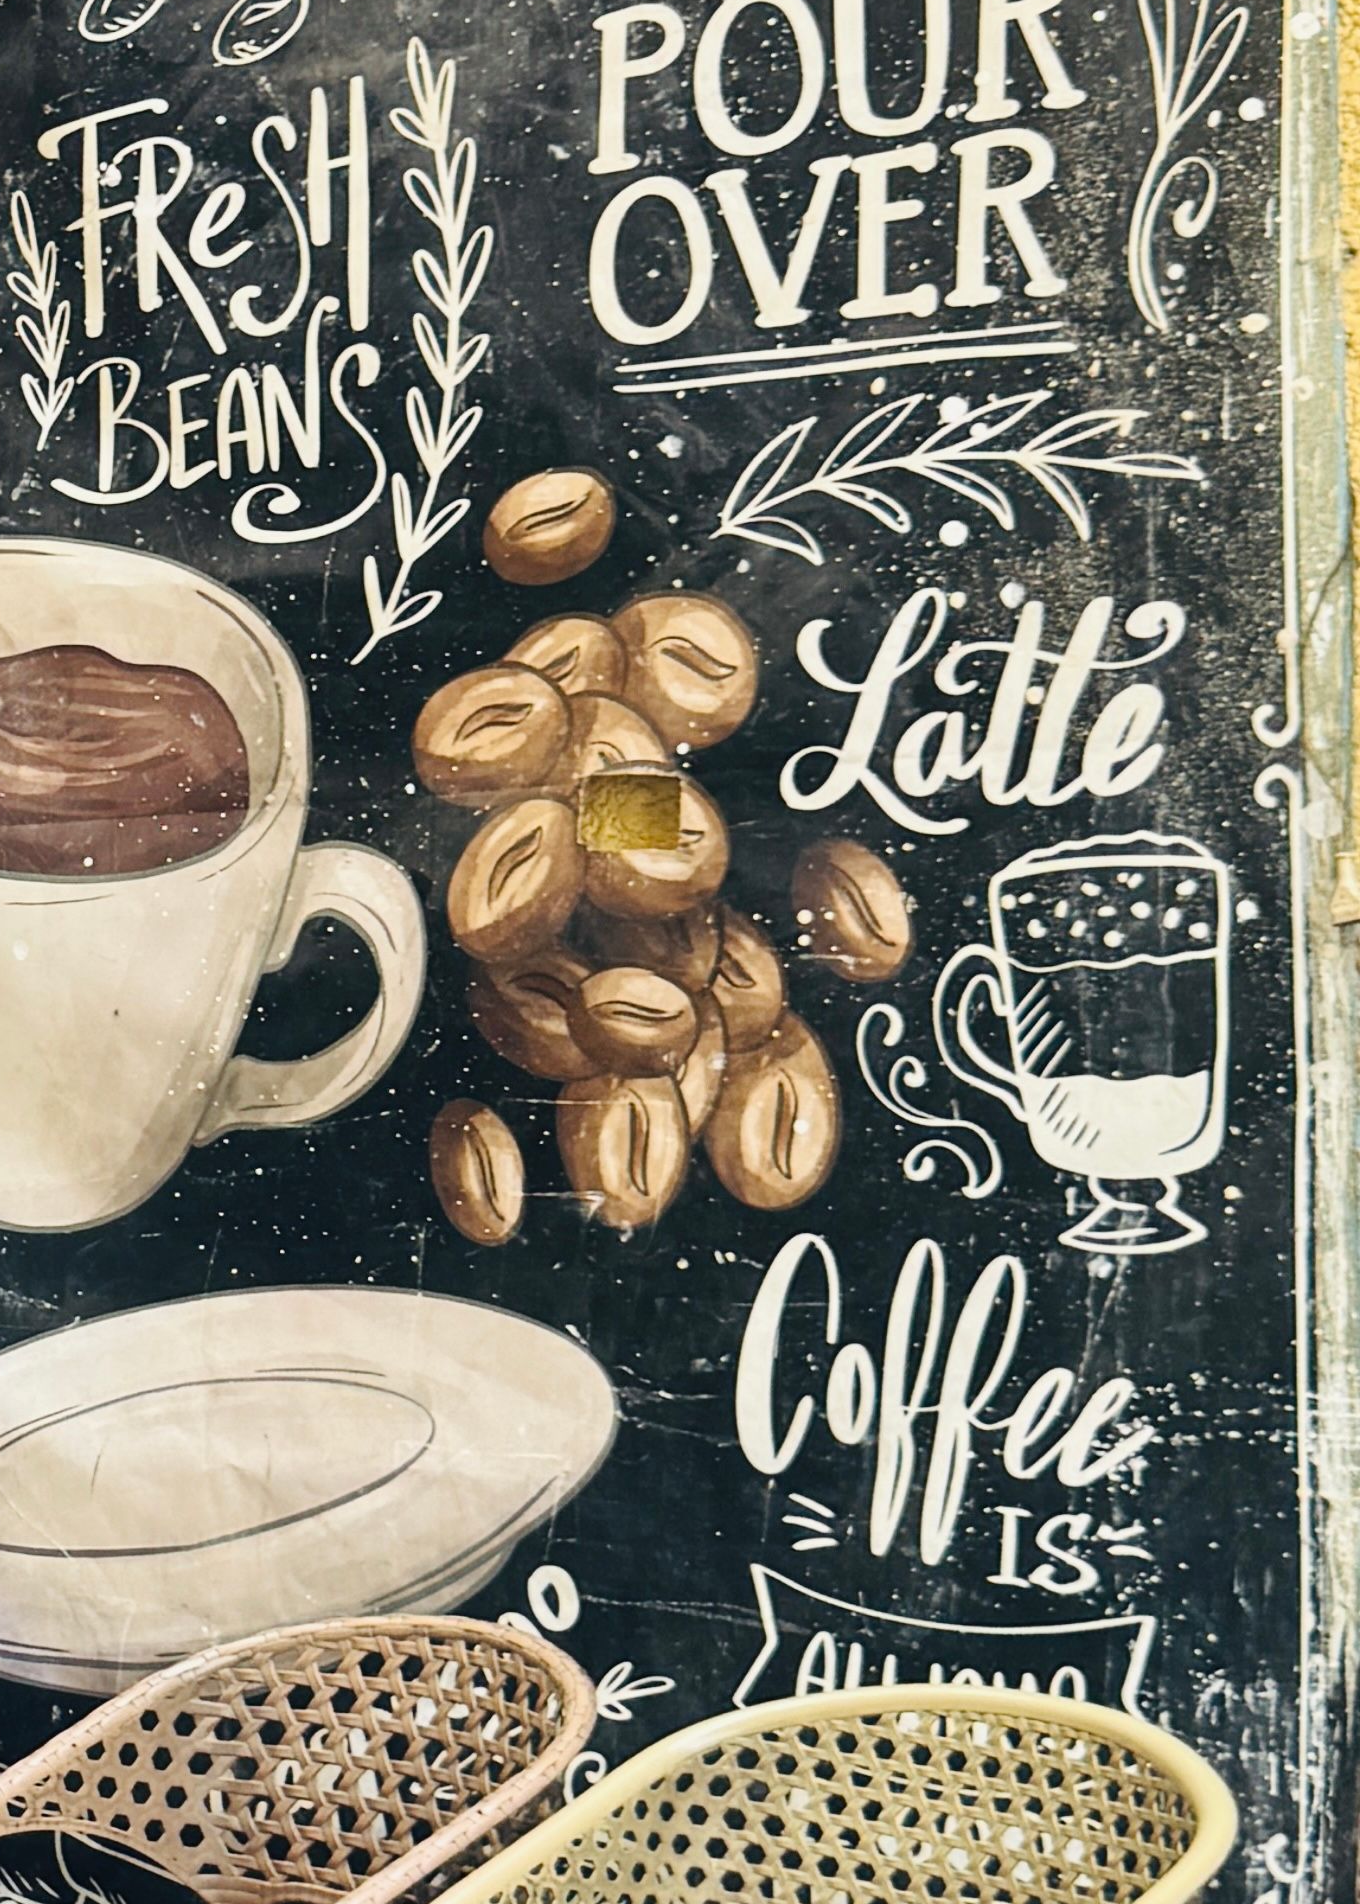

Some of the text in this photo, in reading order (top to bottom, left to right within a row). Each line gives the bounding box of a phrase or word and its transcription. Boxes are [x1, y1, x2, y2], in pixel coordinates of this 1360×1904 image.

[588, 127, 1068, 347] OVER
[49, 295, 387, 544] BEANS
[779, 586, 1186, 837] Latte
[735, 1232, 1155, 1567] Coffee
[985, 1504, 1100, 1596] IS
